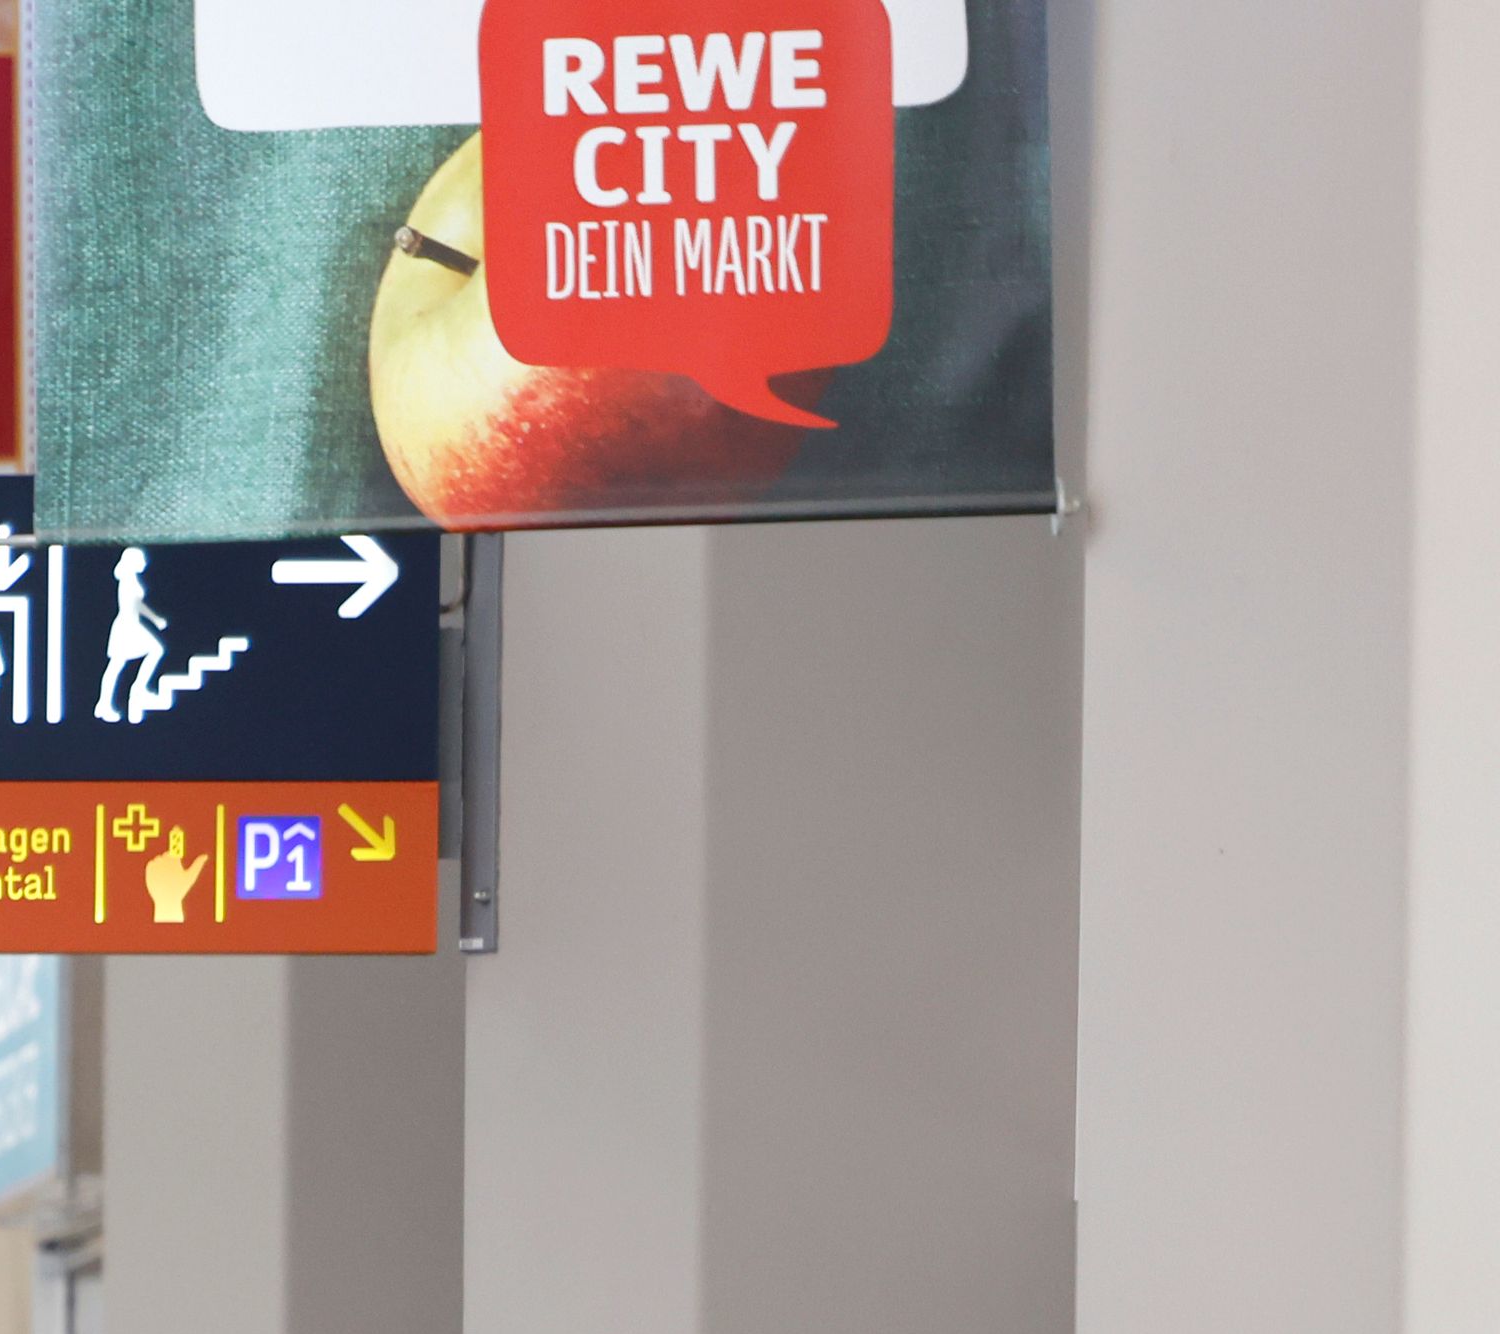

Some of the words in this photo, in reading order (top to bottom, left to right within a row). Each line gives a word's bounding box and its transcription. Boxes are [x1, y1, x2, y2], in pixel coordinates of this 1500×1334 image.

[543, 29, 827, 116] REWE
[573, 122, 797, 207] CITY
[546, 220, 652, 301] DEIN
[675, 214, 827, 297] MARKT
